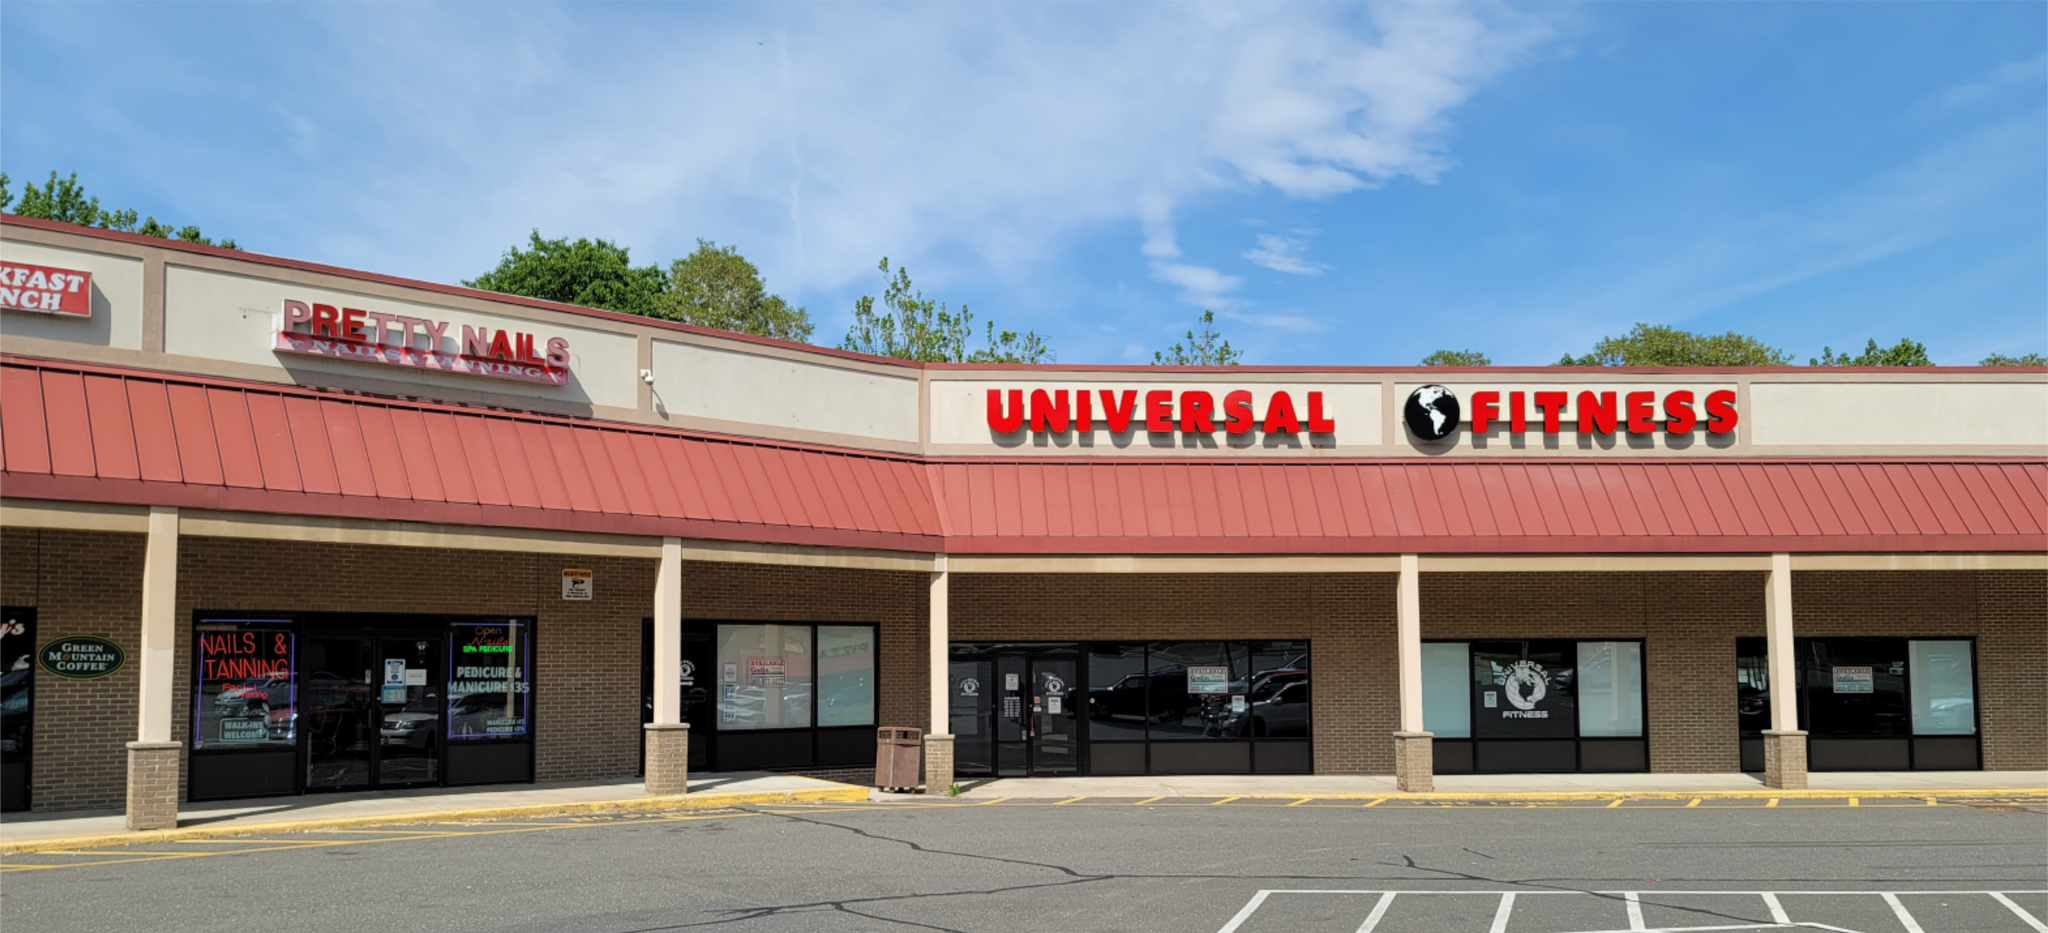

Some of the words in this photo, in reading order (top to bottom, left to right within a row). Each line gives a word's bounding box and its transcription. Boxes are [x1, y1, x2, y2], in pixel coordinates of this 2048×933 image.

[283, 299, 450, 352] PRETTY
[460, 325, 570, 367] NAILS
[311, 340, 401, 360] NAILS
[408, 352, 419, 362] &
[423, 353, 543, 378] TANNING
[986, 388, 1336, 434] UNIVERSAL
[1471, 390, 1739, 434] FITNESS
[475, 626, 502, 637] Open
[61, 643, 104, 653] GREEN
[200, 632, 256, 655] NAILS
[274, 633, 287, 655] &
[462, 645, 477, 653] SPA
[479, 645, 513, 653] PEDICURE
[48, 652, 115, 661] MOUNTAIN
[56, 661, 106, 671] COFFEE
[204, 658, 289, 680] TANNING
[456, 666, 513, 678] PEDICURE
[514, 667, 522, 678] &
[1499, 660, 1552, 686] UNIVERSAL
[447, 681, 508, 693] MANICURE
[1502, 710, 1548, 718] FITNESS
[224, 721, 264, 730] WALK-INS
[224, 731, 263, 739] WELCOME
